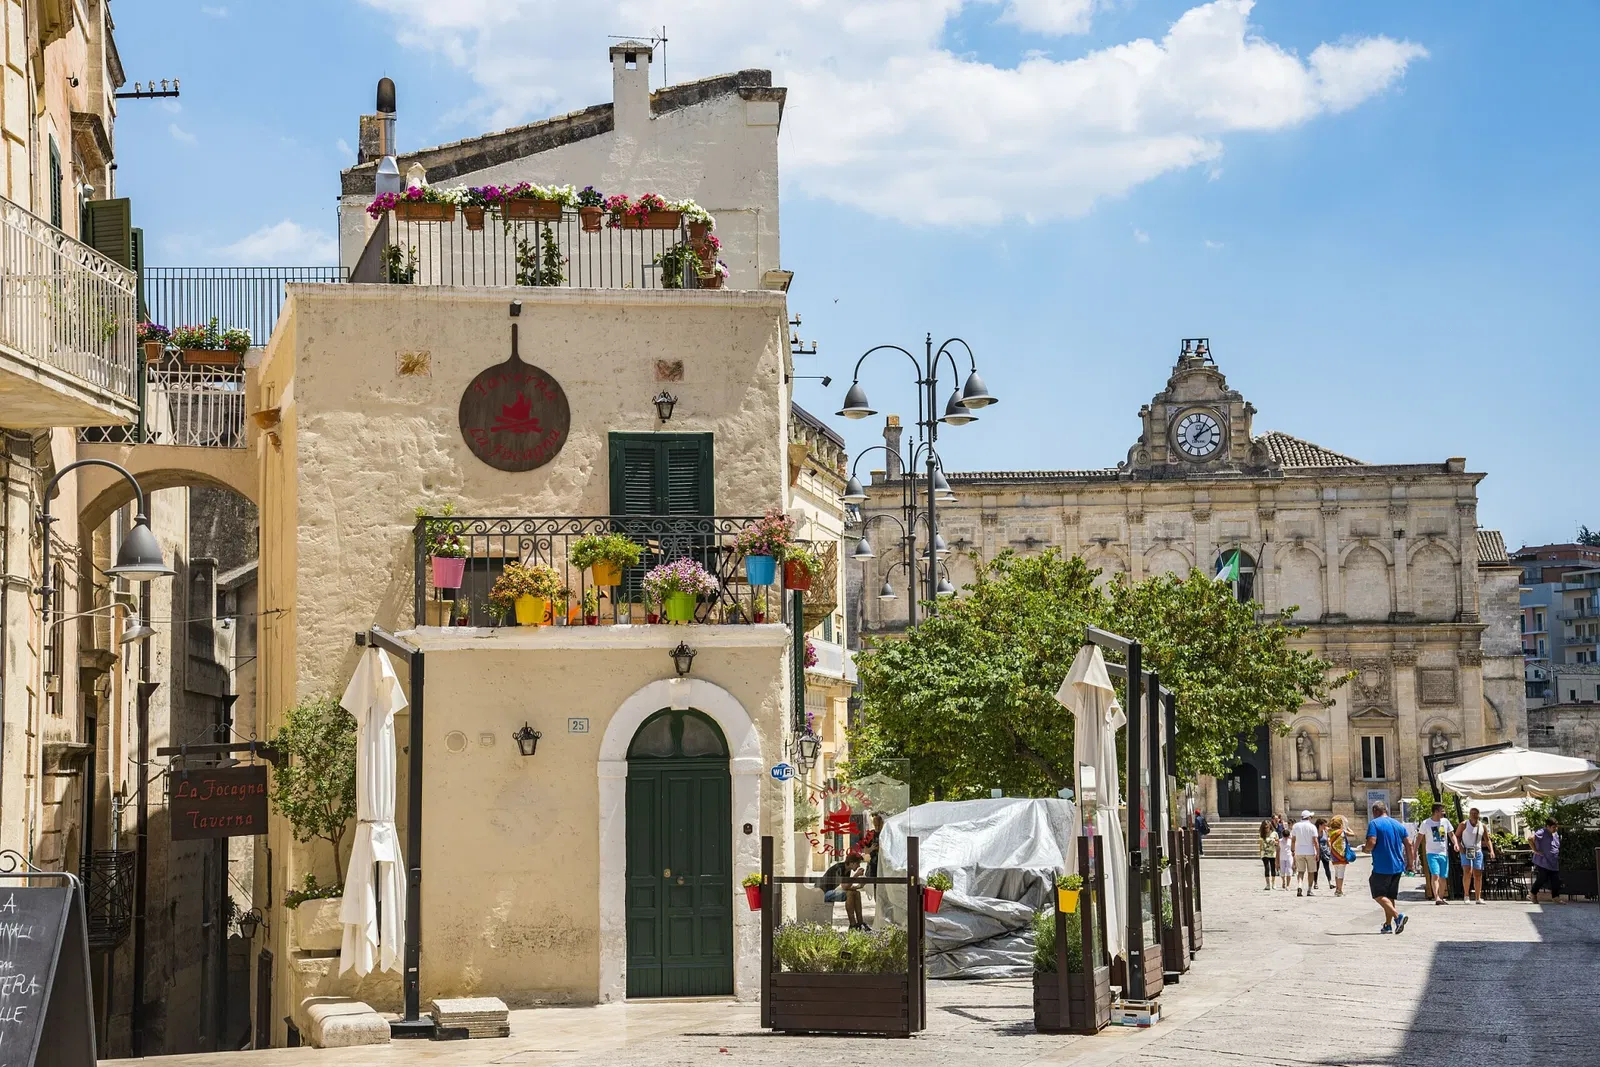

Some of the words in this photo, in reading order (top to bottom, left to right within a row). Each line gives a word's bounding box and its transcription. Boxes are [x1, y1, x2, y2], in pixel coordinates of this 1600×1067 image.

[473, 372, 558, 402] Taverna
[468, 427, 490, 449] La
[486, 426, 561, 462] Focagna
[573, 721, 584, 730] 25
[174, 781, 197, 799] La
[199, 779, 265, 801] Focagna
[808, 784, 872, 808] Taverna
[186, 810, 254, 829] Taverna
[803, 831, 820, 848] La
